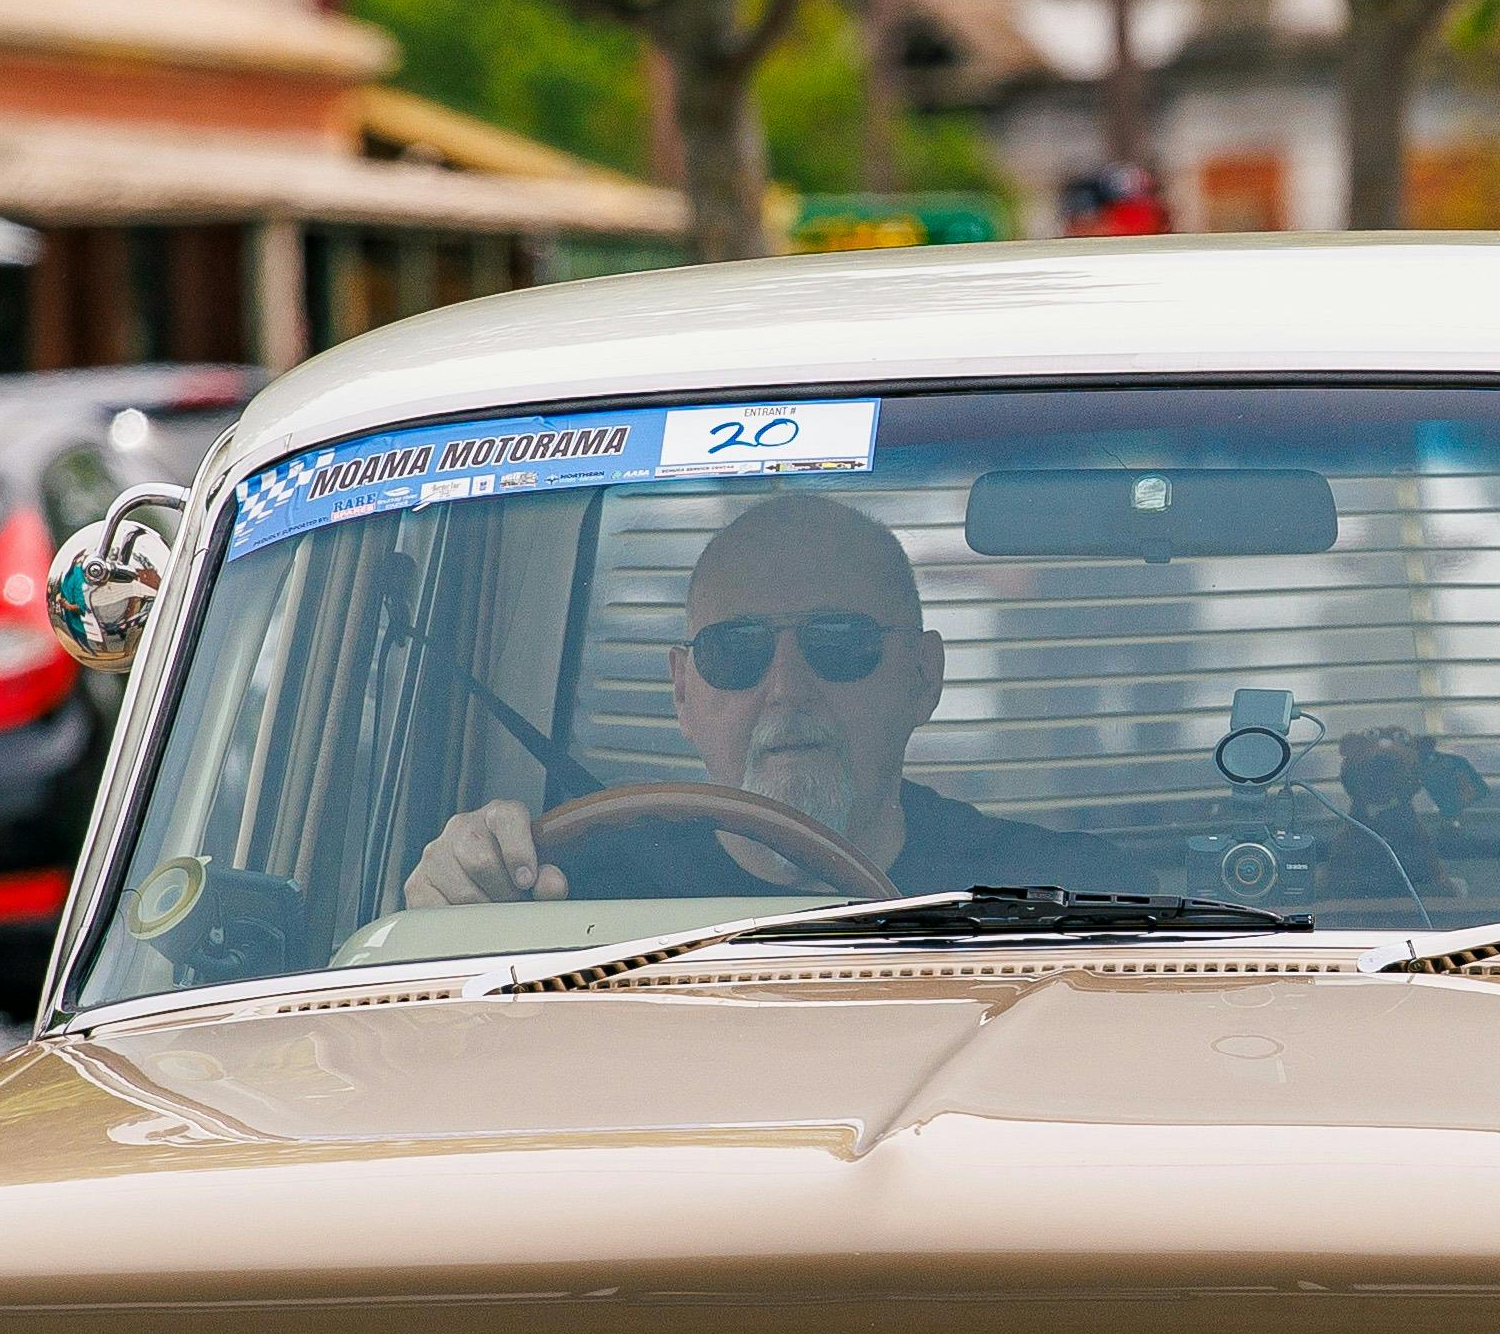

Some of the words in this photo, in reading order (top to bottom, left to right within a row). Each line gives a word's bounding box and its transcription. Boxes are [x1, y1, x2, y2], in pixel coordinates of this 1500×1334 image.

[744, 407, 787, 418] ENTRANT
[708, 418, 800, 454] 20
[308, 445, 435, 501] MOAMA
[437, 426, 630, 472] MOTORAMA
[560, 471, 605, 480] NORTHERN
[333, 492, 378, 513] RARE
